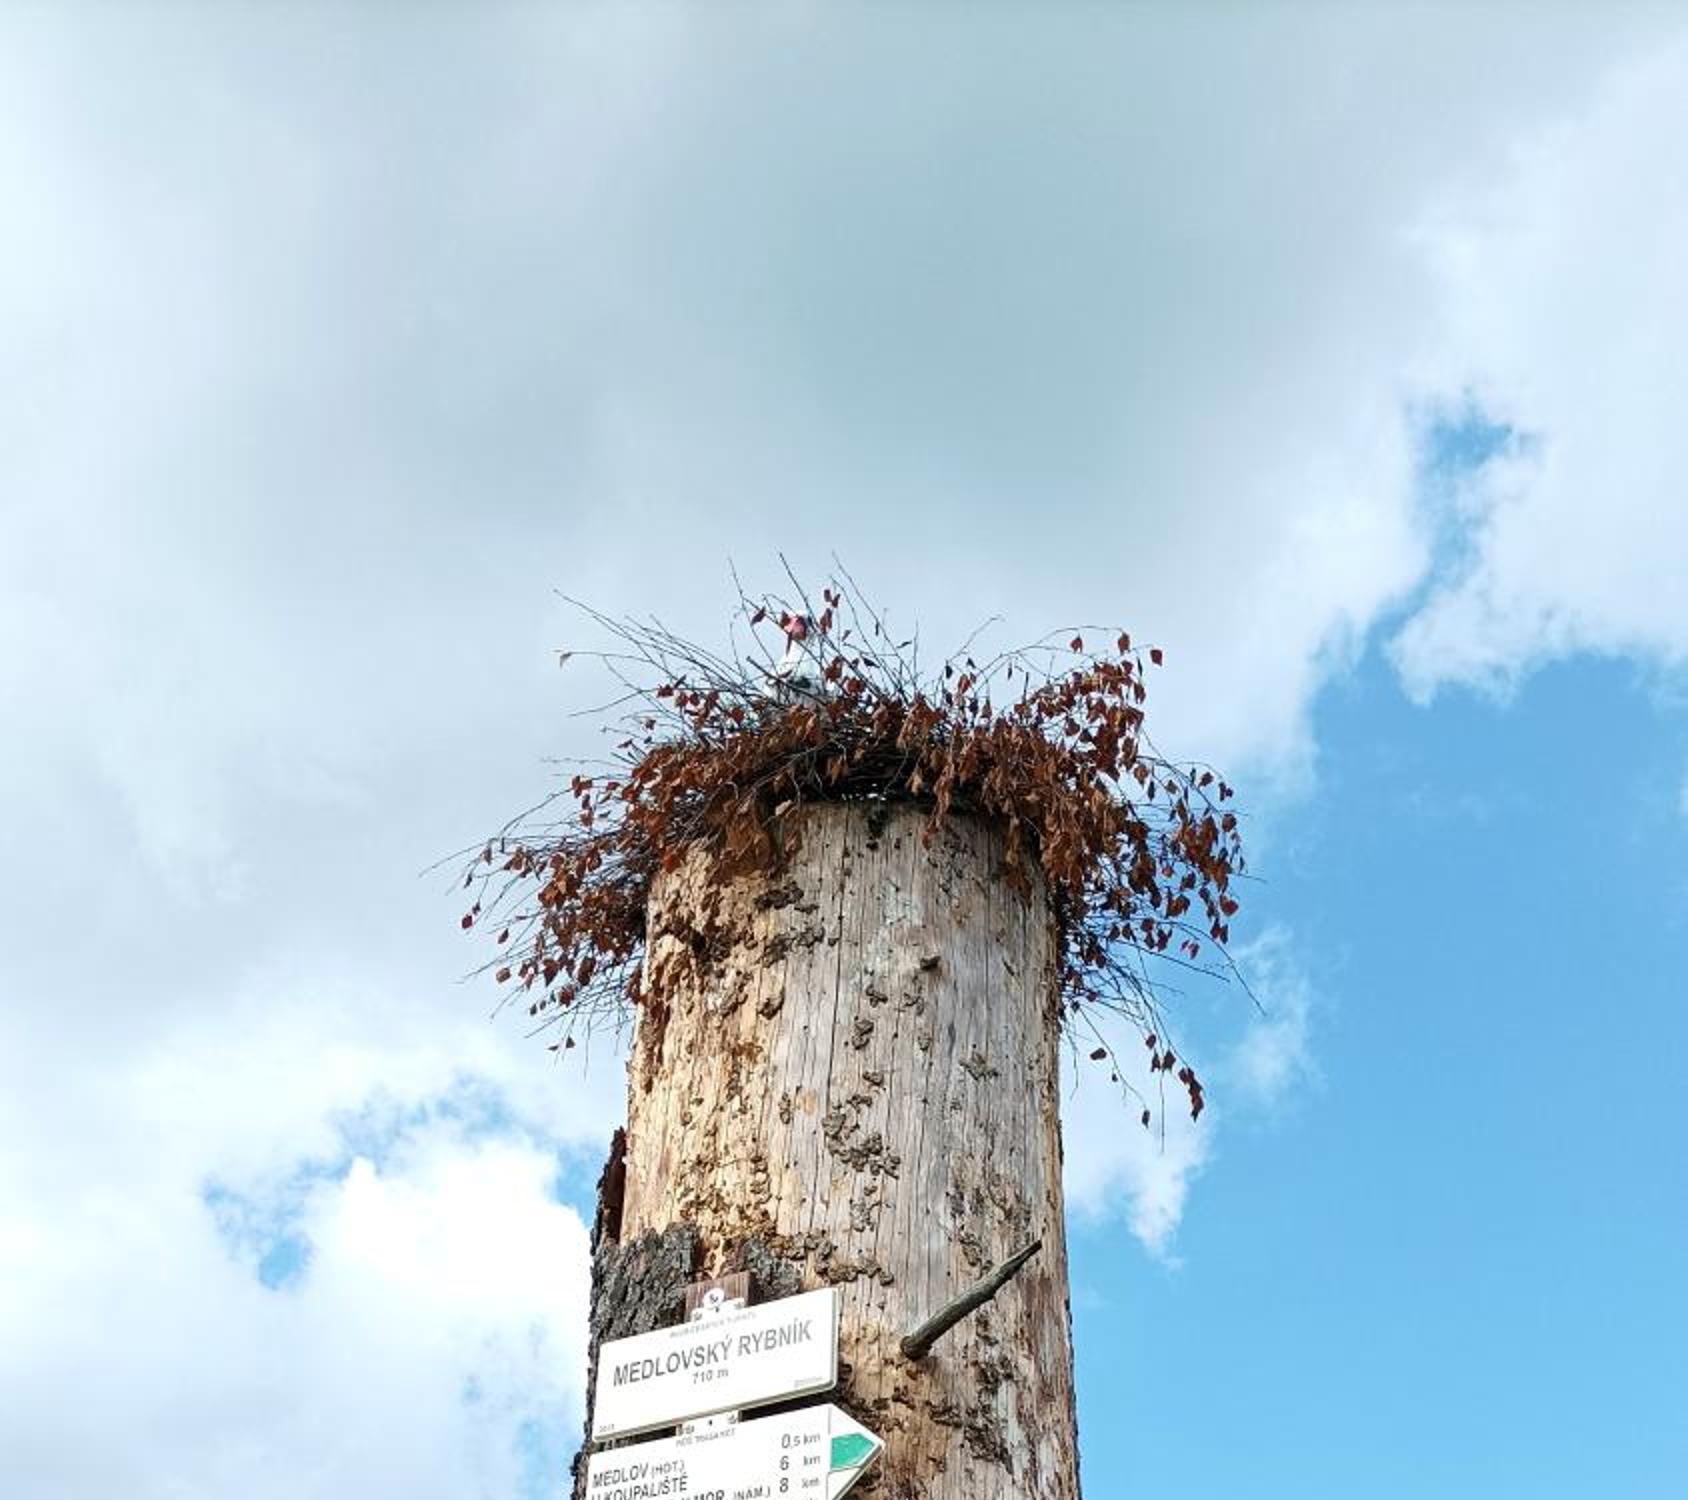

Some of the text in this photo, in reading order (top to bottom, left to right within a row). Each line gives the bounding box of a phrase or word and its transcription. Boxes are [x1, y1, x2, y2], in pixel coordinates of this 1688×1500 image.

[612, 1339, 732, 1387] MEDLOVSKÝ
[737, 1319, 812, 1357] RYBNÍK
[692, 1368, 729, 1385] 710 m
[592, 1462, 649, 1488] MEDLOV
[781, 1433, 800, 1450] 0,5
[803, 1433, 820, 1445] km
[780, 1455, 789, 1471] 6
[803, 1455, 820, 1466] km
[779, 1477, 789, 1493] 8
[802, 1477, 819, 1489] km
